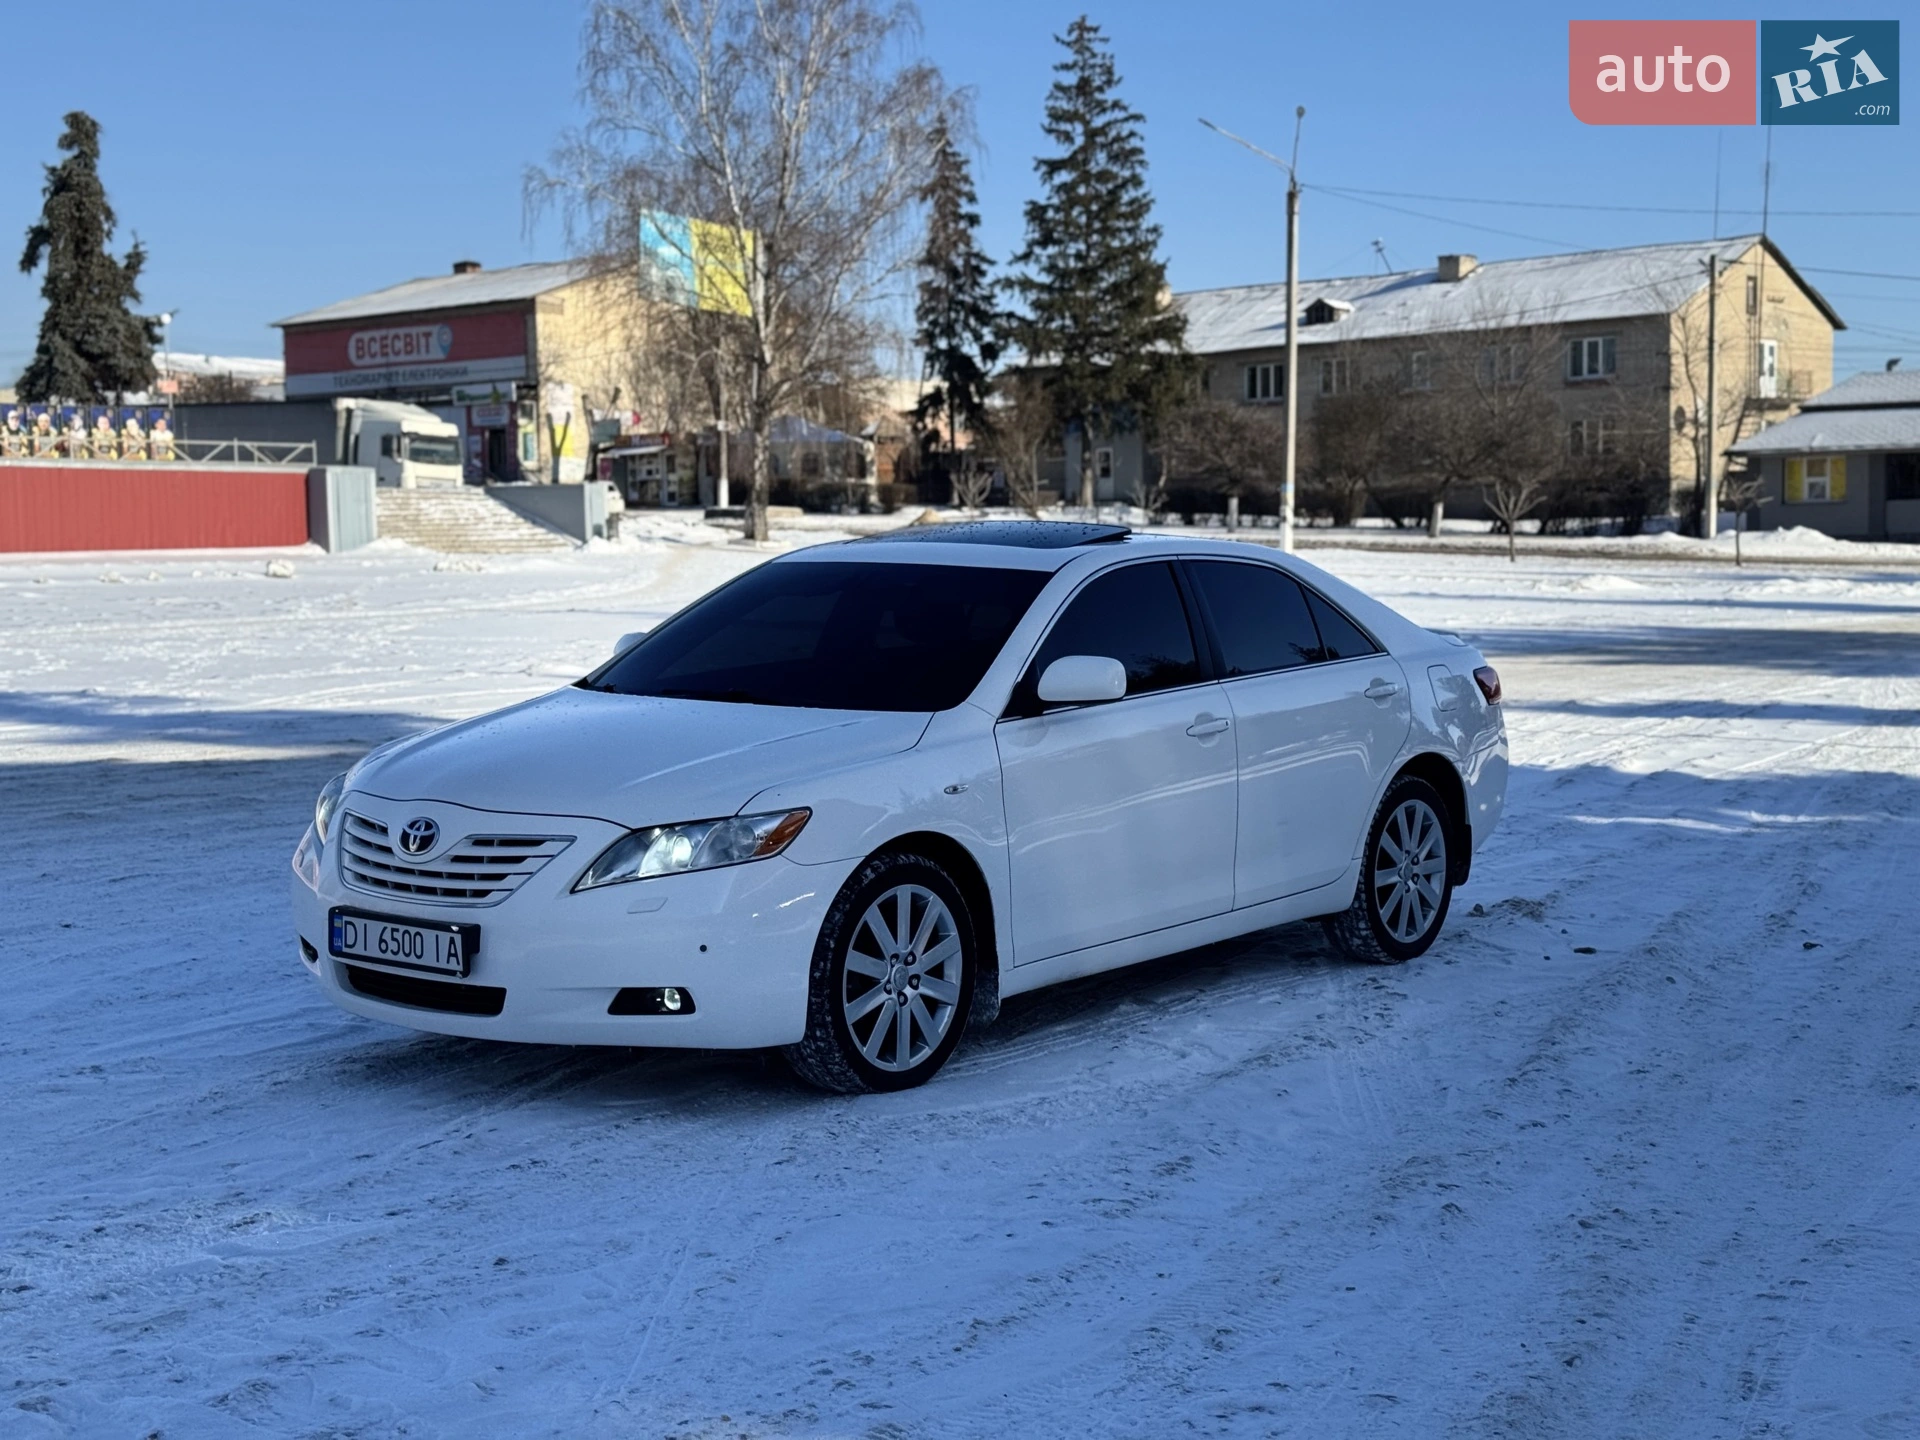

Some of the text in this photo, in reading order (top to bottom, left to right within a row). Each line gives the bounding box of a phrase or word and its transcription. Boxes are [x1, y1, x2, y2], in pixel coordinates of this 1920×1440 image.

[355, 331, 433, 360] ВСЕСВІТ
[333, 937, 342, 947] UA
[343, 920, 461, 966] DI 6500 IA
